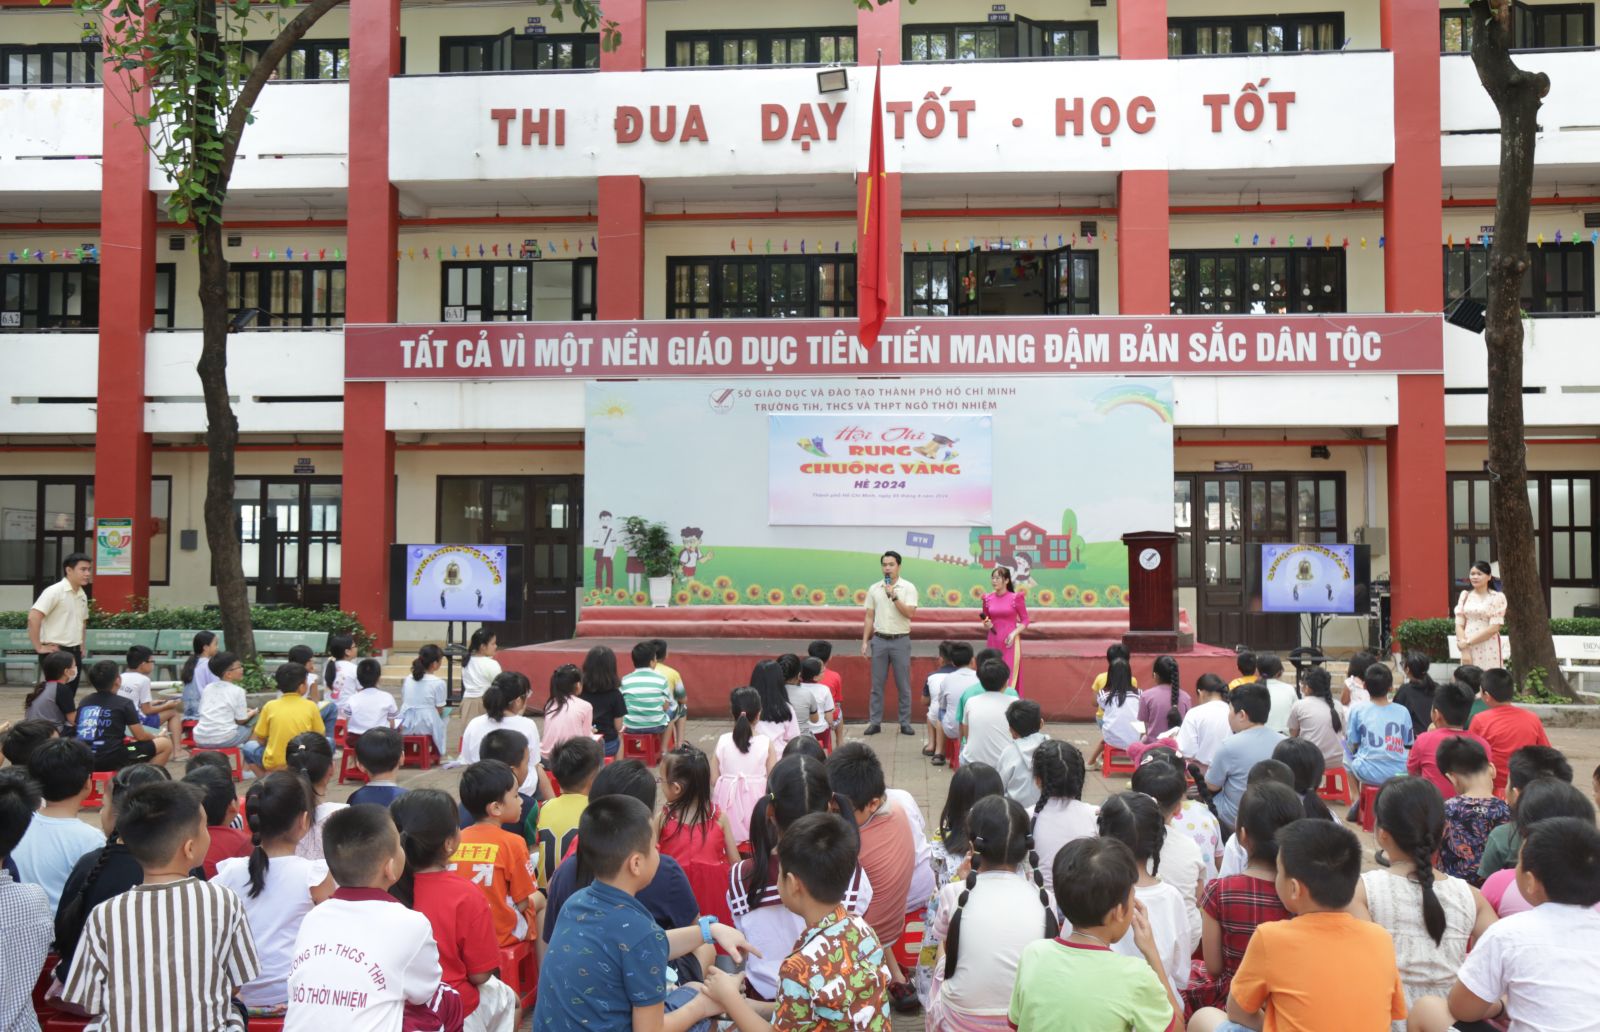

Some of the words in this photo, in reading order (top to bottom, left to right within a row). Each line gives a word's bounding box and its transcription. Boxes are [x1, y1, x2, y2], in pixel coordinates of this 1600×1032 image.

[490, 108, 565, 146] THI
[613, 105, 709, 144] ĐUA
[761, 102, 847, 151] DẠY
[885, 86, 975, 139] TỐT
[1055, 95, 1156, 147] HỌC
[1203, 77, 1296, 133] TỐT
[2, 314, 19, 324] 6A2
[446, 308, 462, 319] 6A1
[400, 329, 448, 369] TẤT
[456, 329, 492, 368] CẢ
[500, 332, 525, 368] VÌ
[534, 331, 594, 373] MỘT
[601, 328, 659, 366] NỀN
[668, 330, 733, 366] GIÁO
[741, 335, 797, 372] DỤC
[806, 329, 869, 365] TIÊN
[877, 325, 940, 364] TIẾN
[950, 333, 1035, 364] MANG
[1044, 327, 1110, 370] ĐẬM
[1119, 323, 1179, 363] BẢN
[1188, 321, 1247, 363] SẮC
[1256, 326, 1317, 362] DÂN
[1325, 325, 1382, 368] TỘC
[738, 388, 751, 398] SỞ
[755, 387, 781, 398] GIÁO
[785, 389, 807, 400] DỤC
[810, 387, 824, 398] VÀ
[828, 386, 851, 398] ĐÀO
[855, 388, 875, 399] TẠO
[879, 386, 915, 397] THÀNH
[920, 385, 942, 396] PHỐ
[946, 385, 961, 396] HỒ
[965, 385, 983, 396] CHÍ
[987, 386, 1016, 396] MINH
[754, 402, 799, 412] TRƯỜNG
[826, 402, 853, 412] THCS
[857, 401, 870, 411] VÀ
[873, 402, 902, 411] THPT
[905, 400, 928, 410] NGÔ
[932, 400, 958, 410] THỜI
[962, 400, 997, 411] NHIỆM
[848, 445, 912, 456] RUNG
[799, 461, 895, 475] CHUÔNG
[899, 461, 961, 475] VÀNG
[854, 479, 870, 489] HÈ
[873, 480, 906, 489] 2024
[314, 943, 327, 956] TH
[336, 943, 365, 964] THCS
[368, 963, 387, 992] THPT
[306, 984, 331, 1005] THỜI
[332, 988, 369, 1012] NHIỆM
